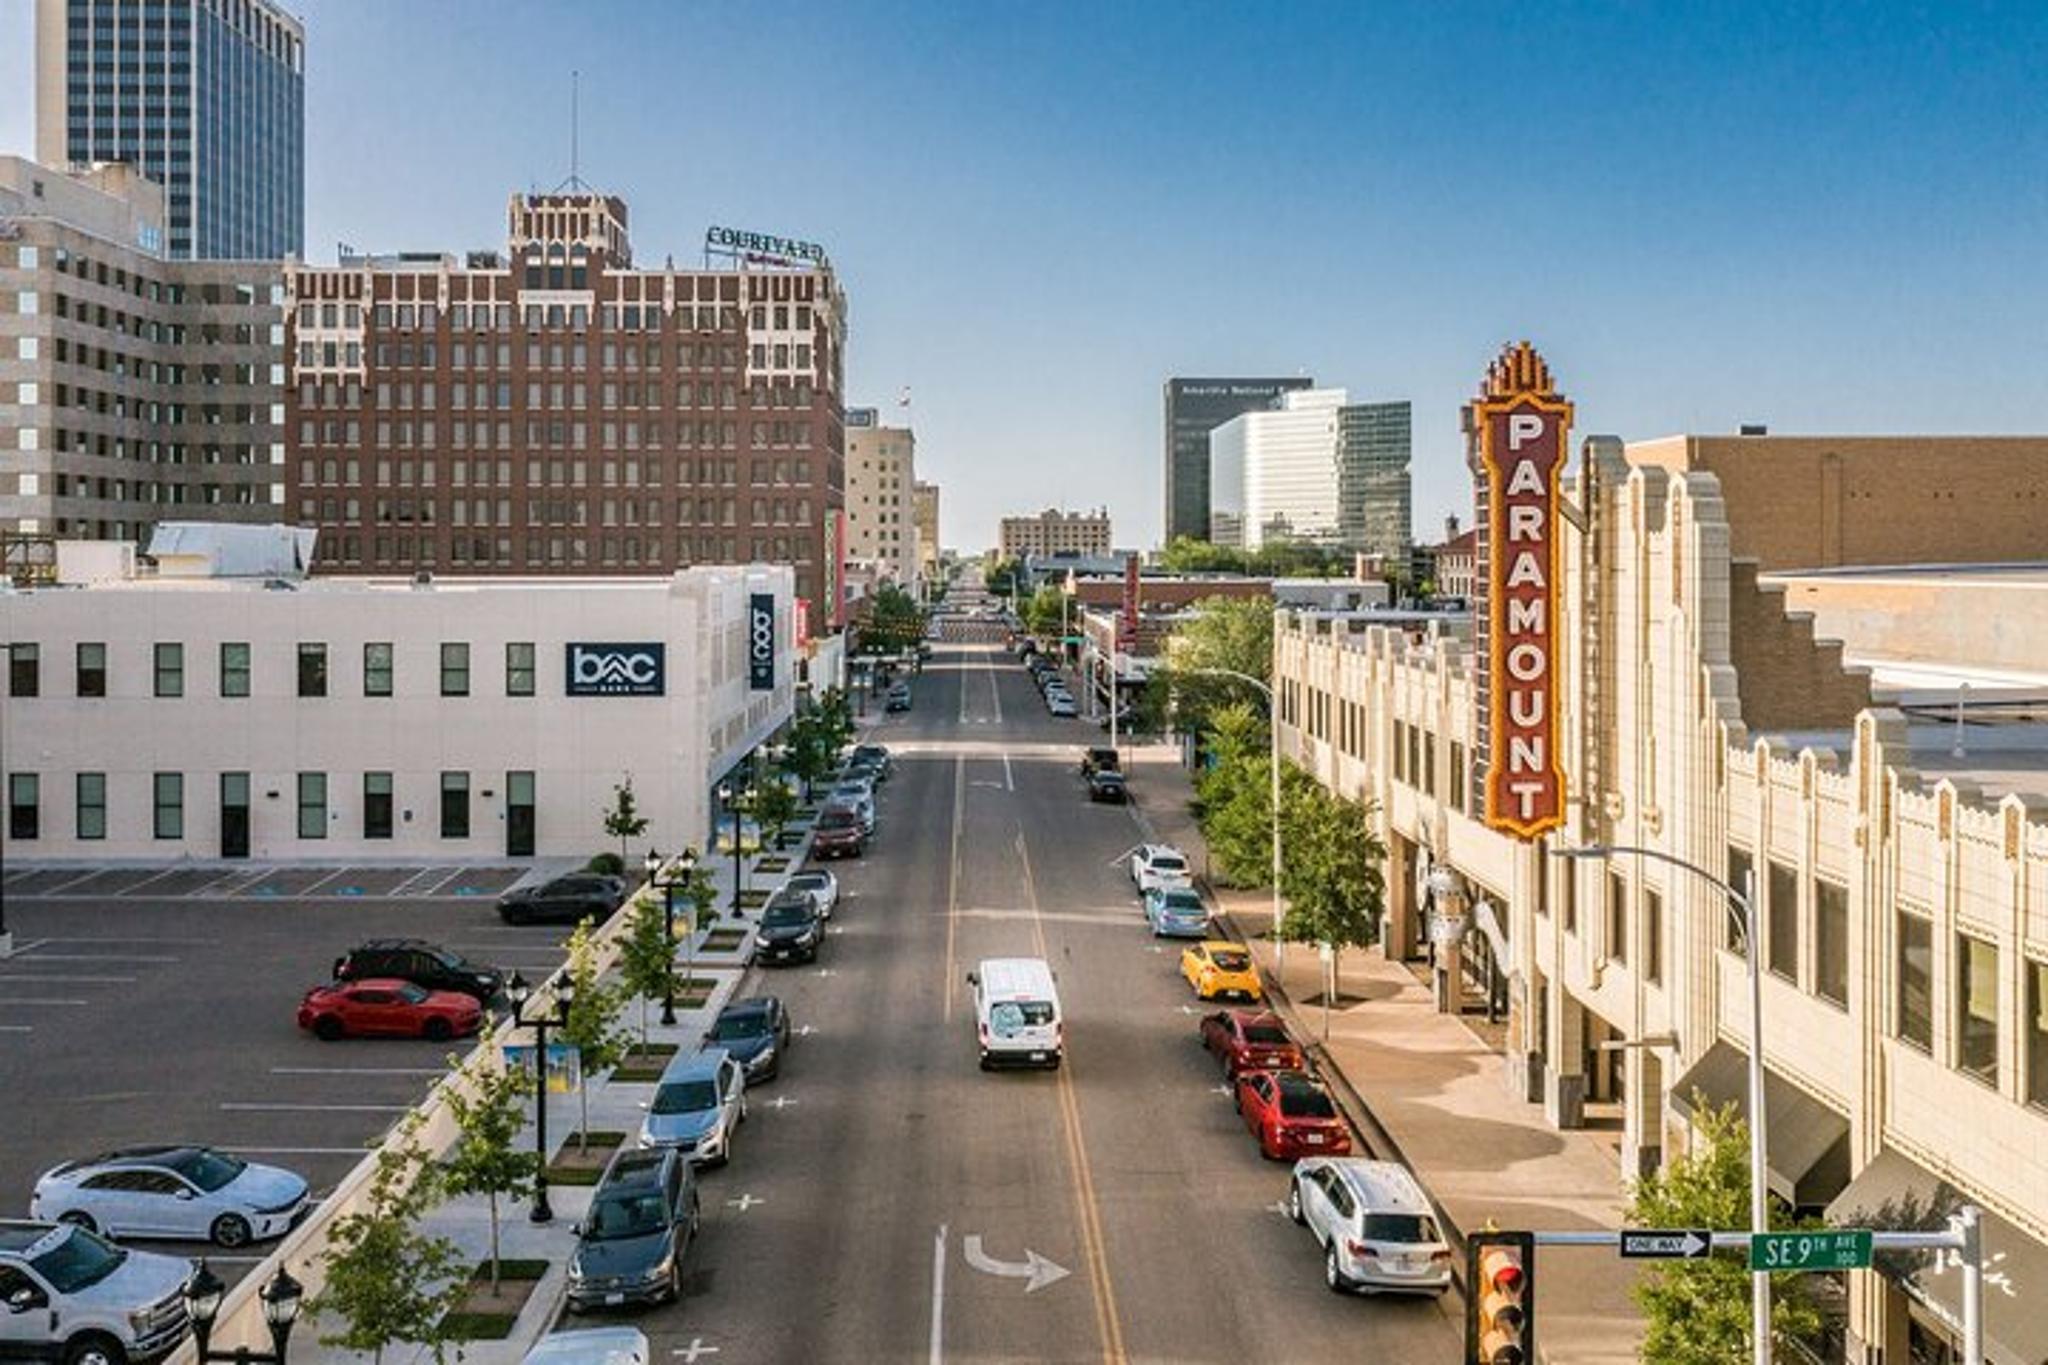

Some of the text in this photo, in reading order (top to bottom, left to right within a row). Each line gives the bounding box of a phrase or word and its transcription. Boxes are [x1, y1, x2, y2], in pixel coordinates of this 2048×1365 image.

[707, 226, 824, 260] COURTYARD
[1506, 414, 1547, 819] PARAMOUNT
[1629, 1238, 1684, 1250] ONE WAY
[1765, 1239, 1794, 1266] SE
[1834, 1234, 1858, 1249] AVE
